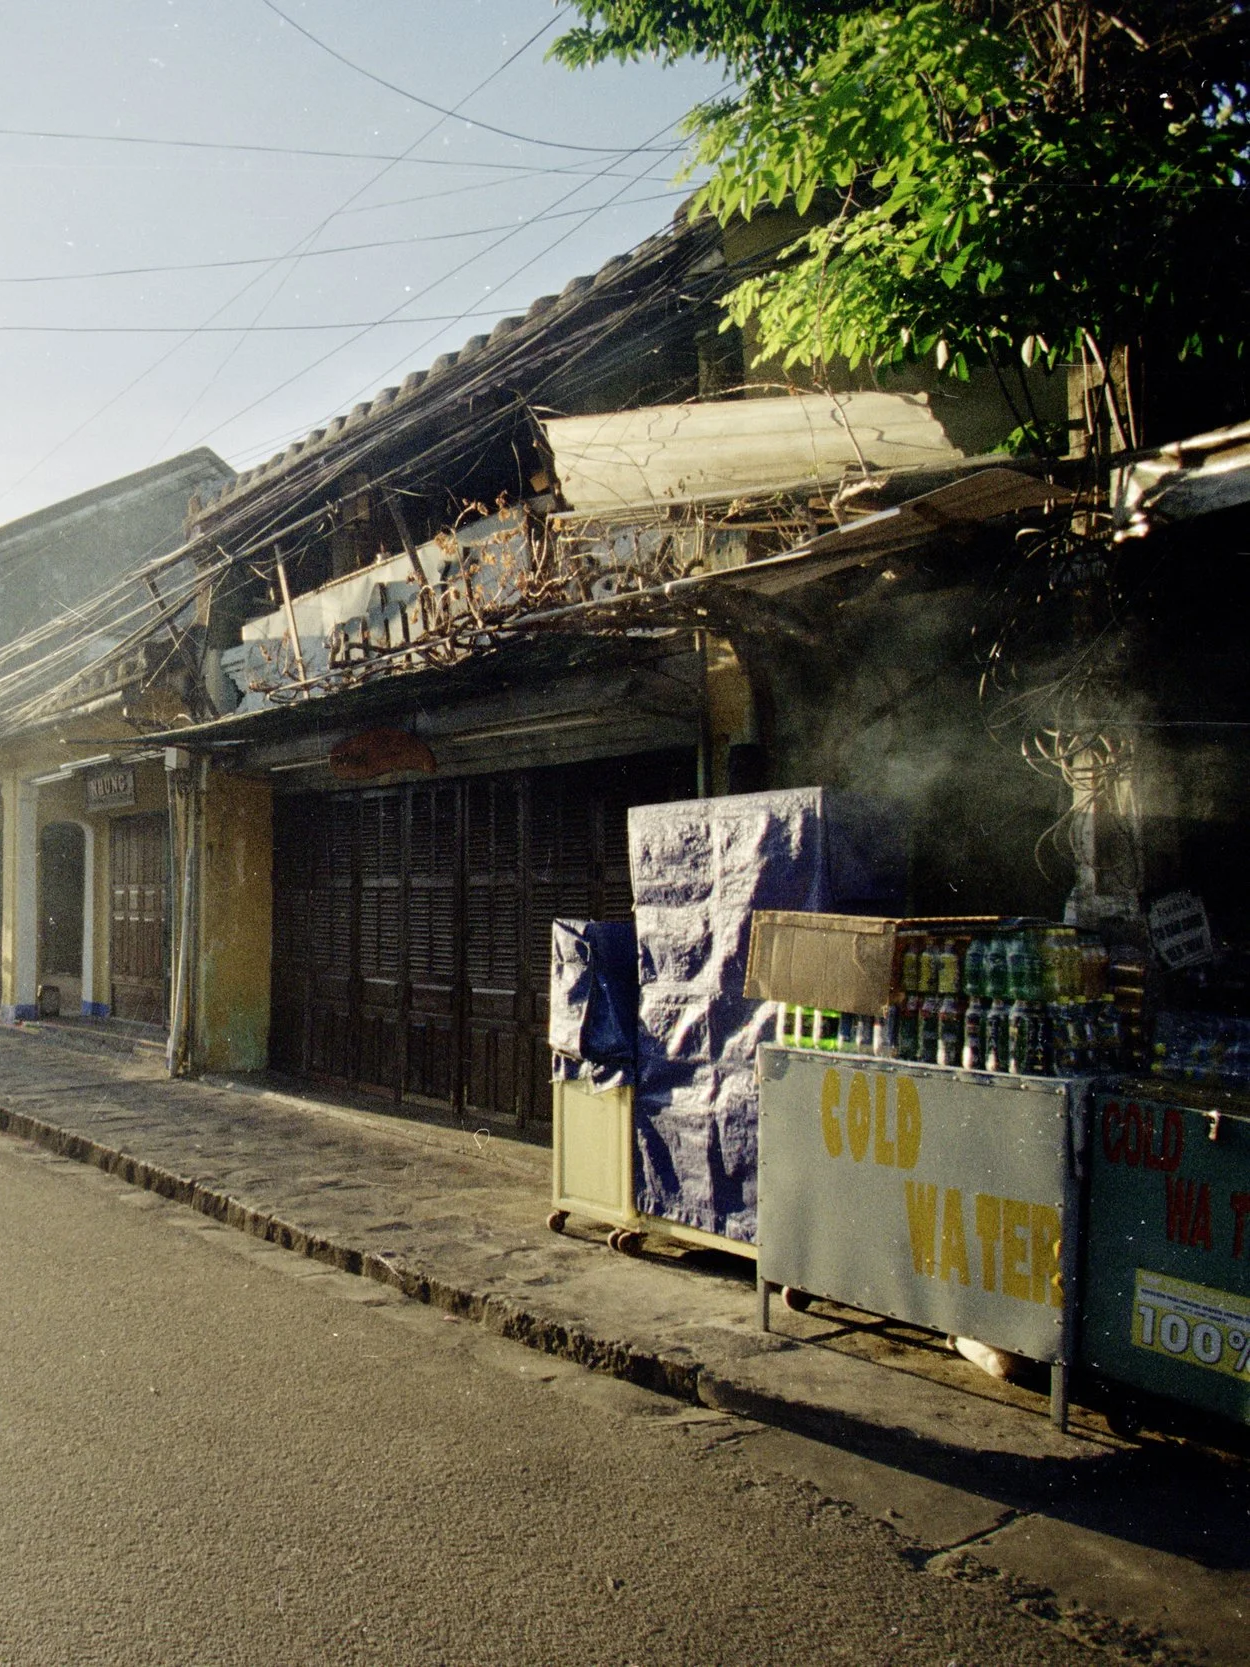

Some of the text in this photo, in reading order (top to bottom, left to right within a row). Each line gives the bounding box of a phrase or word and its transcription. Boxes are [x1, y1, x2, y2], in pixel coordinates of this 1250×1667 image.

[821, 1067, 922, 1170] COLD
[1102, 1100, 1185, 1172] COLD
[905, 1179, 1065, 1309] WATER
